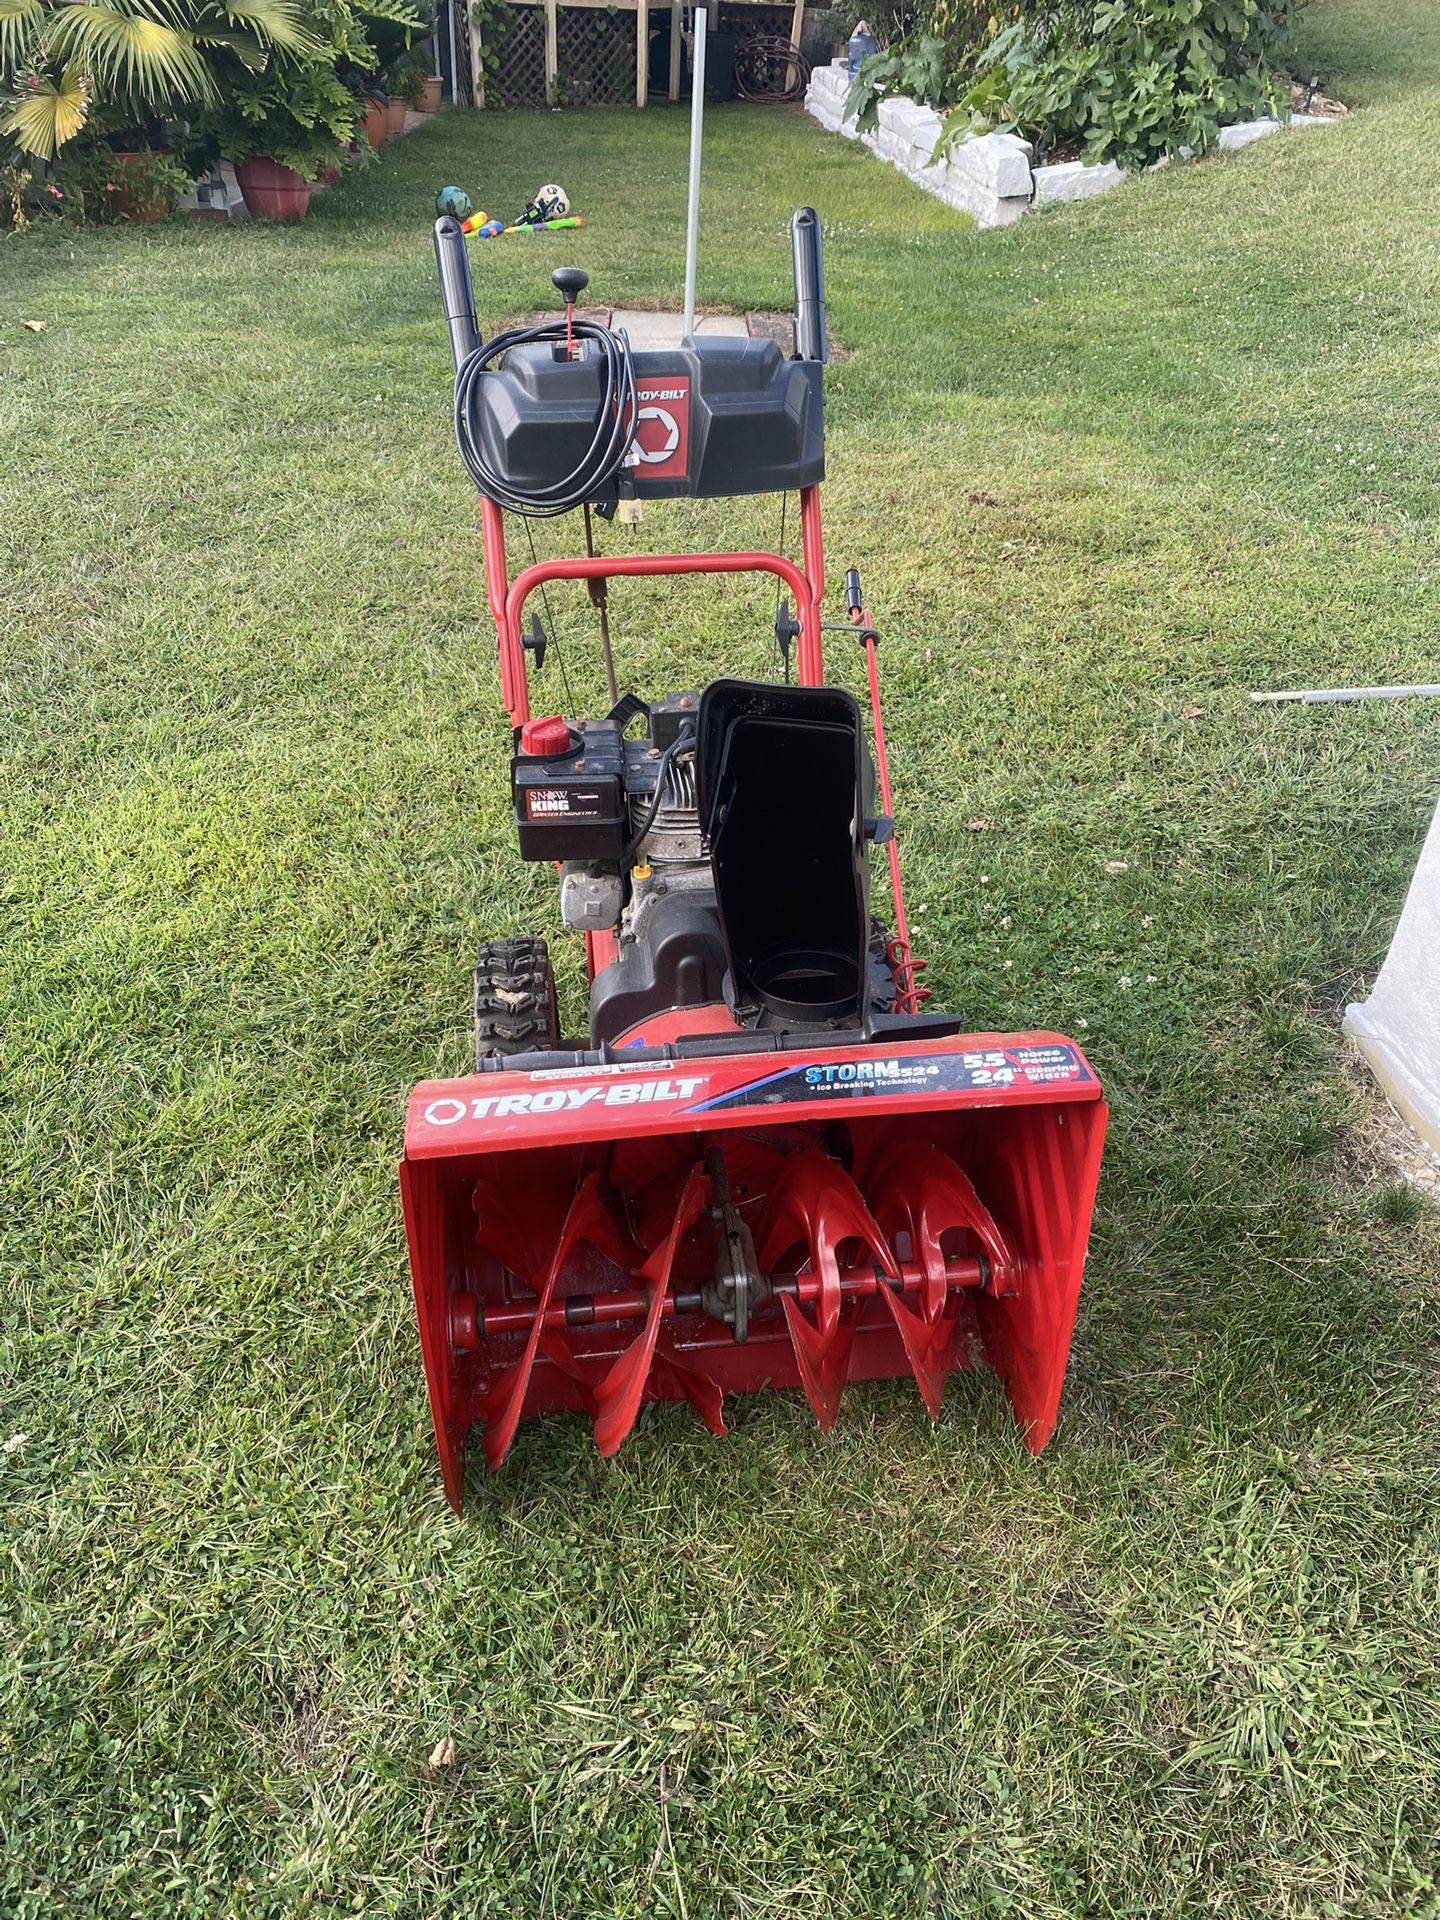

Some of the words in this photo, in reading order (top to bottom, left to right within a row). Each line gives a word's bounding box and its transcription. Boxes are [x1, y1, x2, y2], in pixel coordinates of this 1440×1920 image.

[530, 800, 569, 811] KING
[963, 1052, 1006, 1069] 5.5
[1018, 1050, 1061, 1058] Horse
[1020, 1056, 1066, 1065] Power
[805, 1061, 899, 1084] STORM
[833, 1080, 875, 1090] Breaking
[876, 1077, 928, 1087] Technology
[471, 1078, 705, 1119] TROY-BILT
